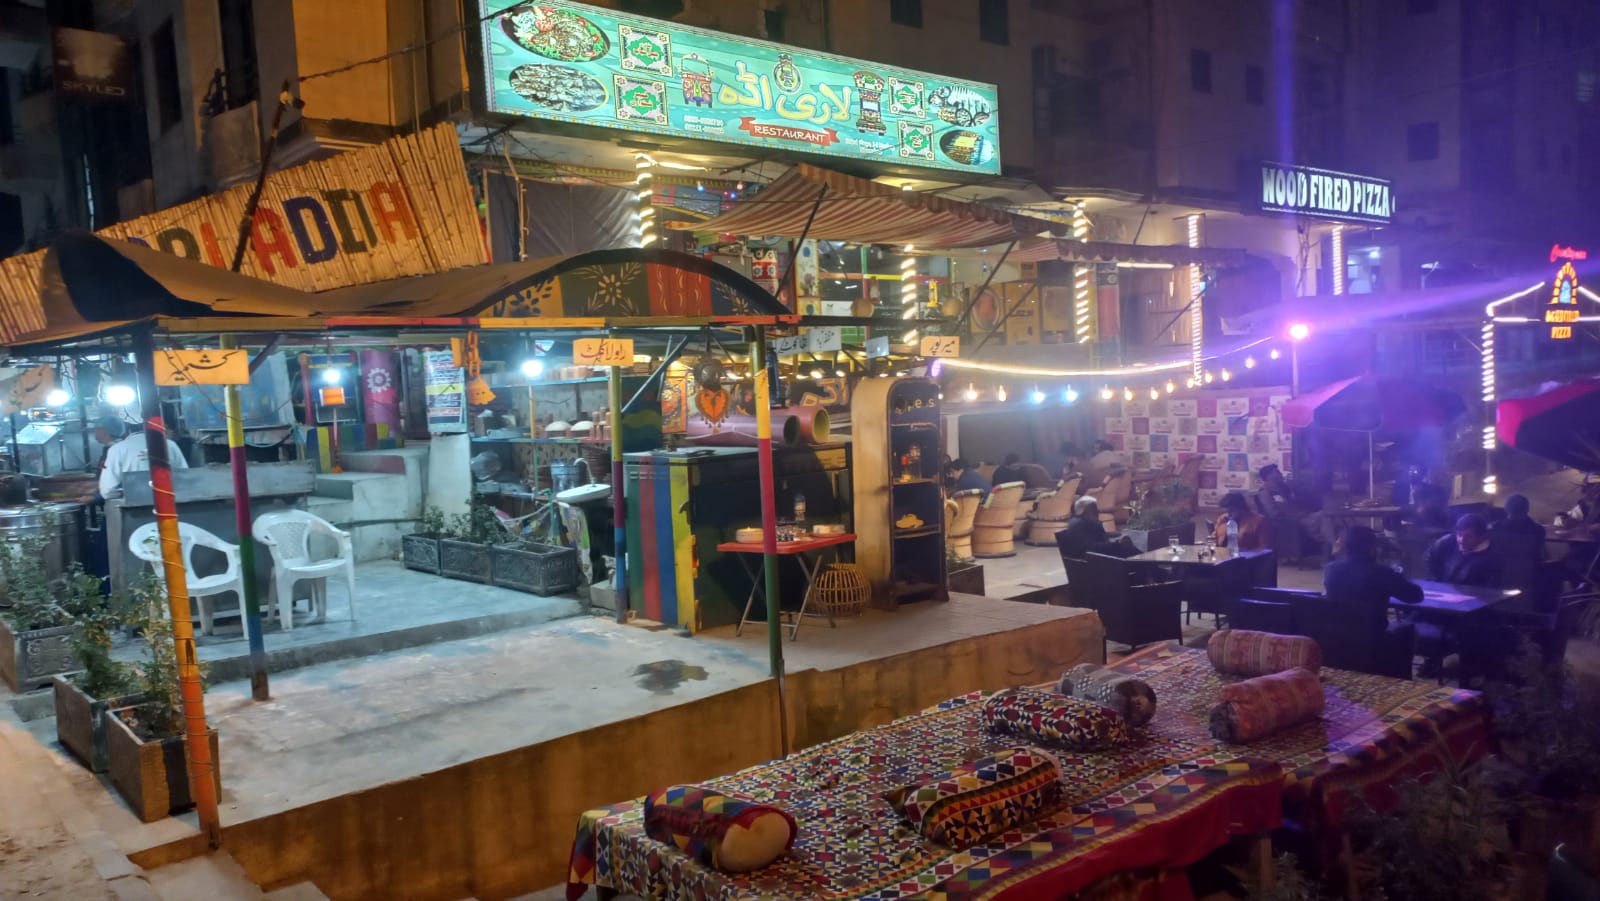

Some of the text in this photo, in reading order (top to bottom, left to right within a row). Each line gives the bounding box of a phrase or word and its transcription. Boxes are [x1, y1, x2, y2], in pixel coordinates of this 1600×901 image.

[753, 125, 826, 143] RESTAURANT
[1261, 167, 1390, 217] WOOD FIRED PIZZA
[252, 181, 418, 277] ADDA
